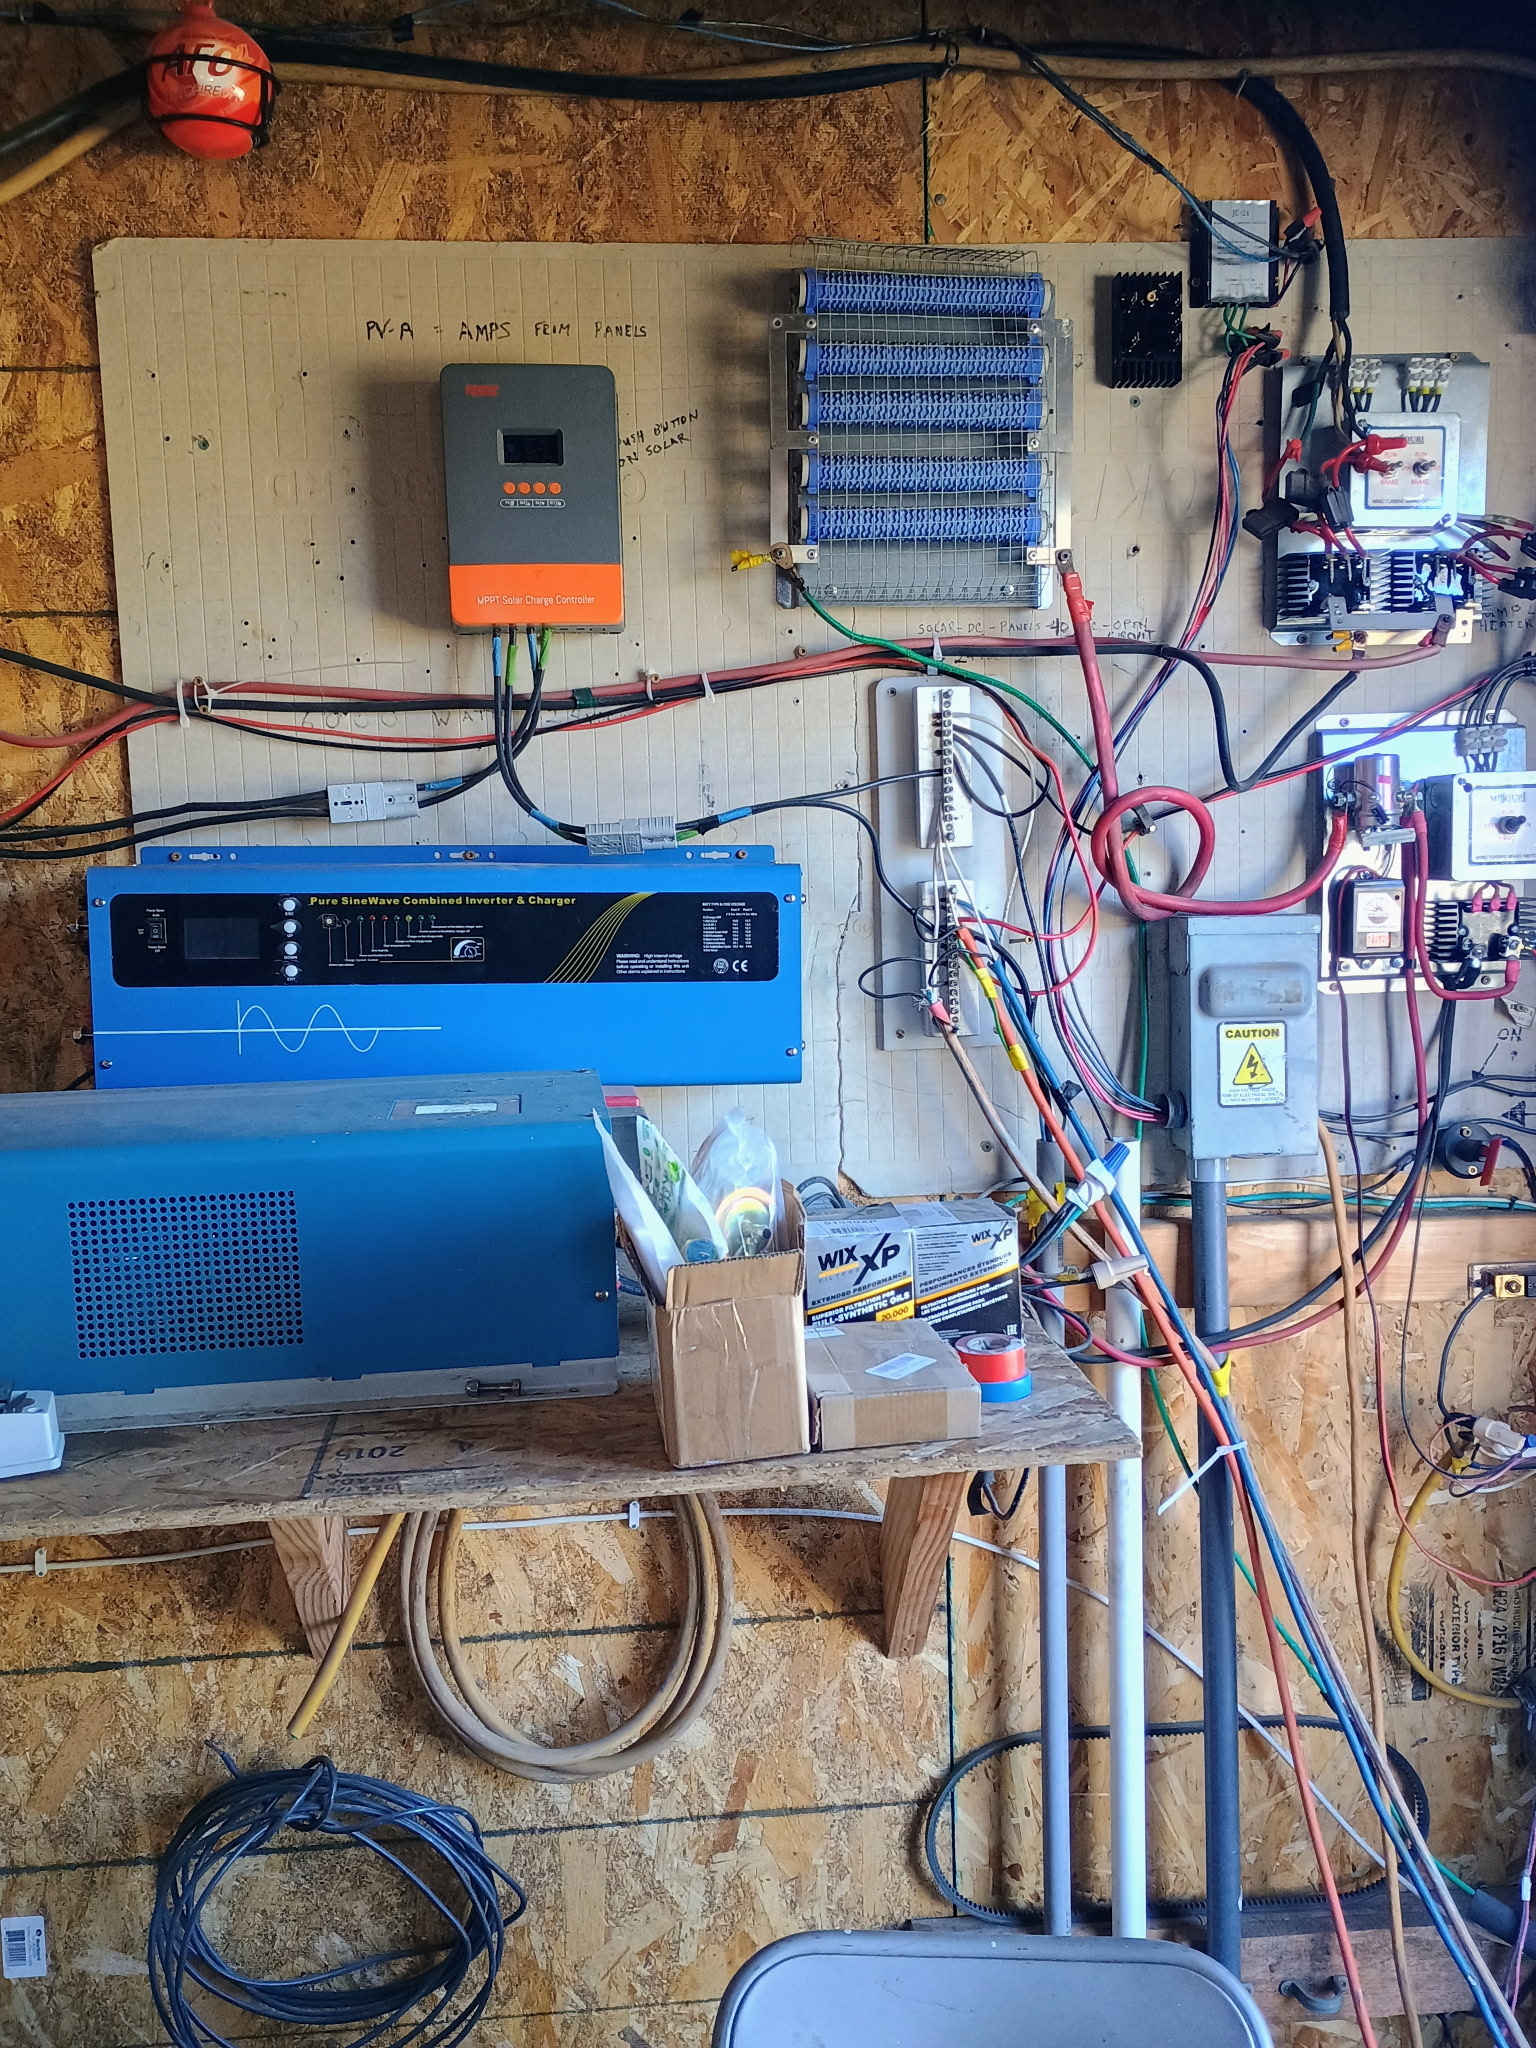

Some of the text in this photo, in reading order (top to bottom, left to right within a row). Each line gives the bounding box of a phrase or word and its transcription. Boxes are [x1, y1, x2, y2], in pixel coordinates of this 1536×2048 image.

[459, 321, 510, 342] AMPS
[594, 321, 647, 338] PANELS
[645, 432, 692, 456] SOLAR
[476, 594, 595, 607] MPPT Solar Charge Controller
[310, 895, 576, 907] Pure SineWave Combined Inverter & Charger
[732, 959, 748, 973] CE
[1225, 1028, 1280, 1039] CAUTION
[1496, 1027, 1523, 1043] ON
[971, 1221, 1013, 1250] WIX XP
[817, 1244, 859, 1272] WIX
[852, 1233, 901, 1287] XP
[919, 1265, 976, 1288] PERFORMANCES
[977, 1251, 1012, 1270] ÉTENDUES
[811, 1270, 907, 1306] EXTENDED PERFORMANCE
[919, 1259, 1009, 1295] RENDIMIENTO EXTENDIDO
[811, 1290, 895, 1322] SUPERIOR FILTRATION FOR
[811, 1291, 910, 1327] FULL-SYNTHETIC OILS
[335, 1445, 407, 1461] 2015
[1451, 1595, 1461, 1685] EXTERIOR TYPE
